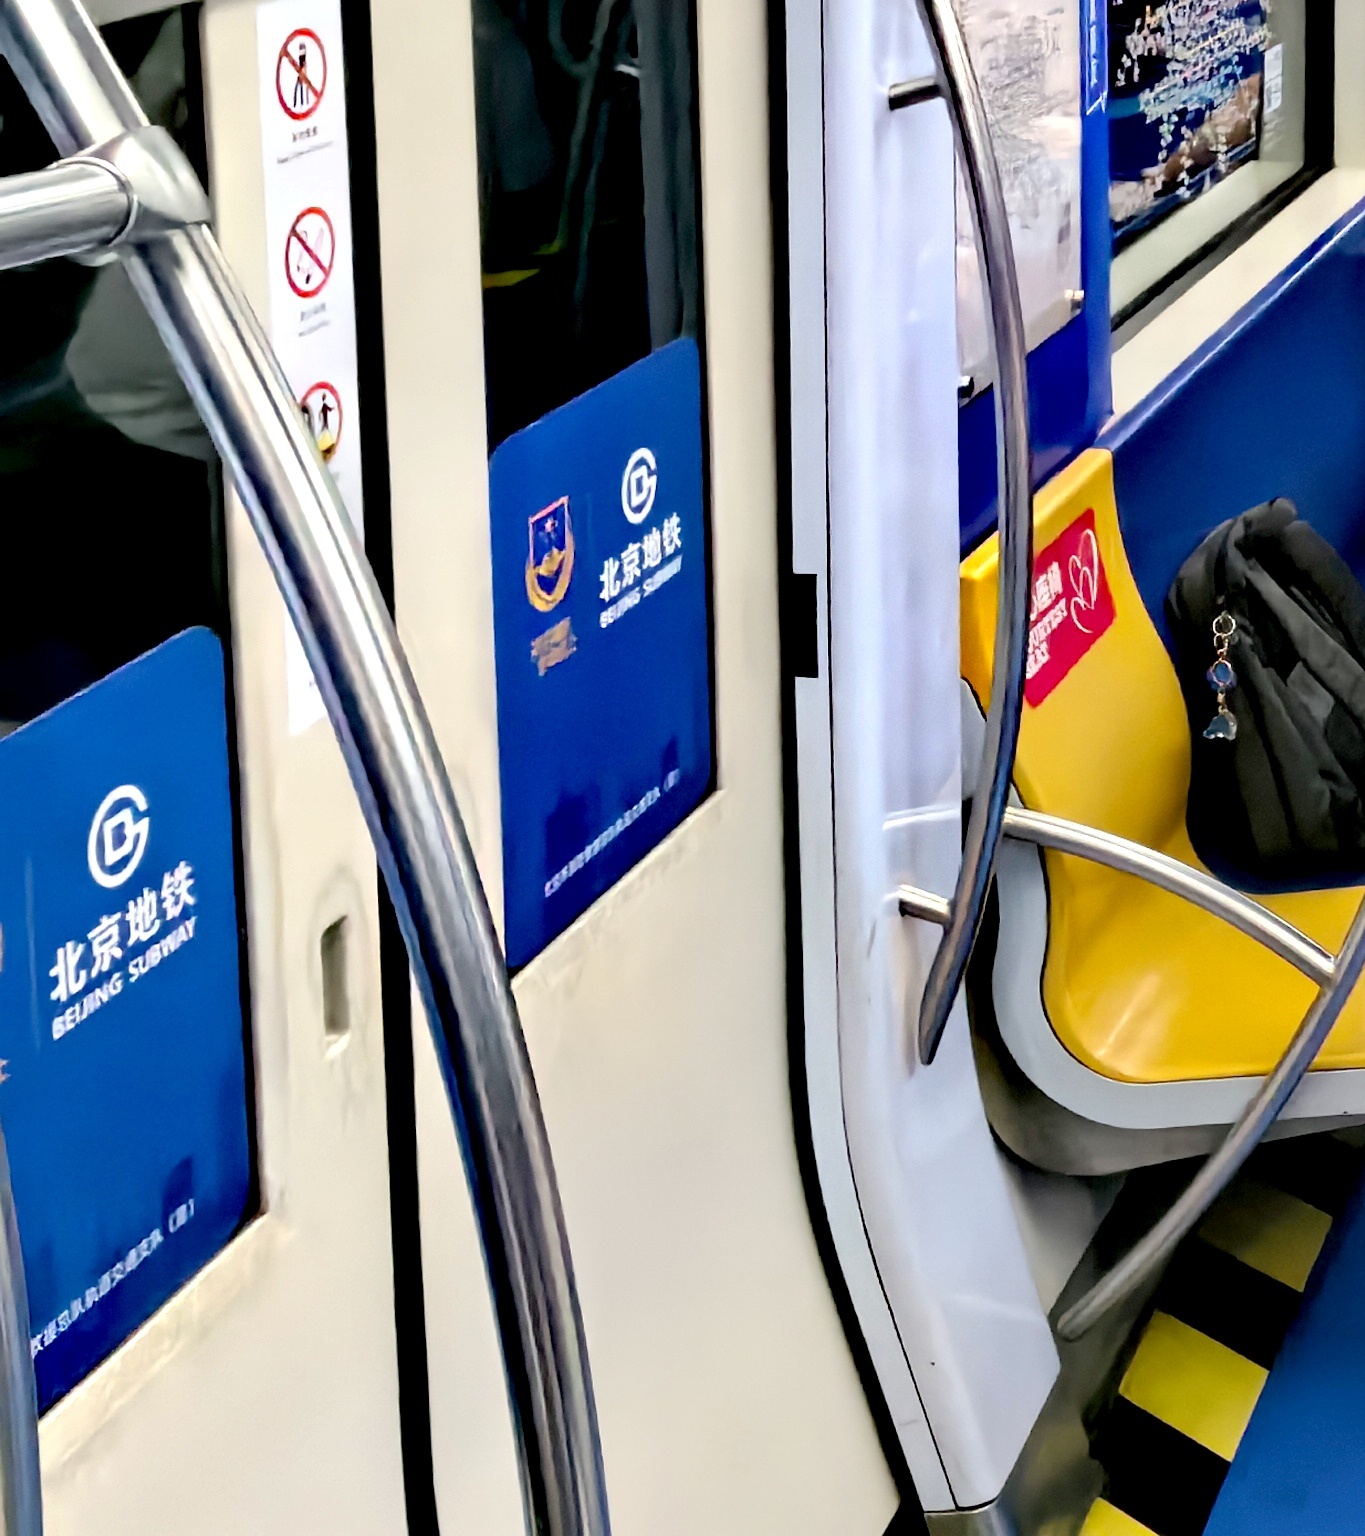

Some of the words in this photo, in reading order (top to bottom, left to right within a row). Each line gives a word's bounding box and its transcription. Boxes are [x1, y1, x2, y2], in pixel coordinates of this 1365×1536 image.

[600, 512, 682, 603] 北京地铁
[49, 860, 197, 1003] 北京地铁
[52, 971, 125, 1042] BEIJING
[128, 915, 198, 983] SUBWAY
